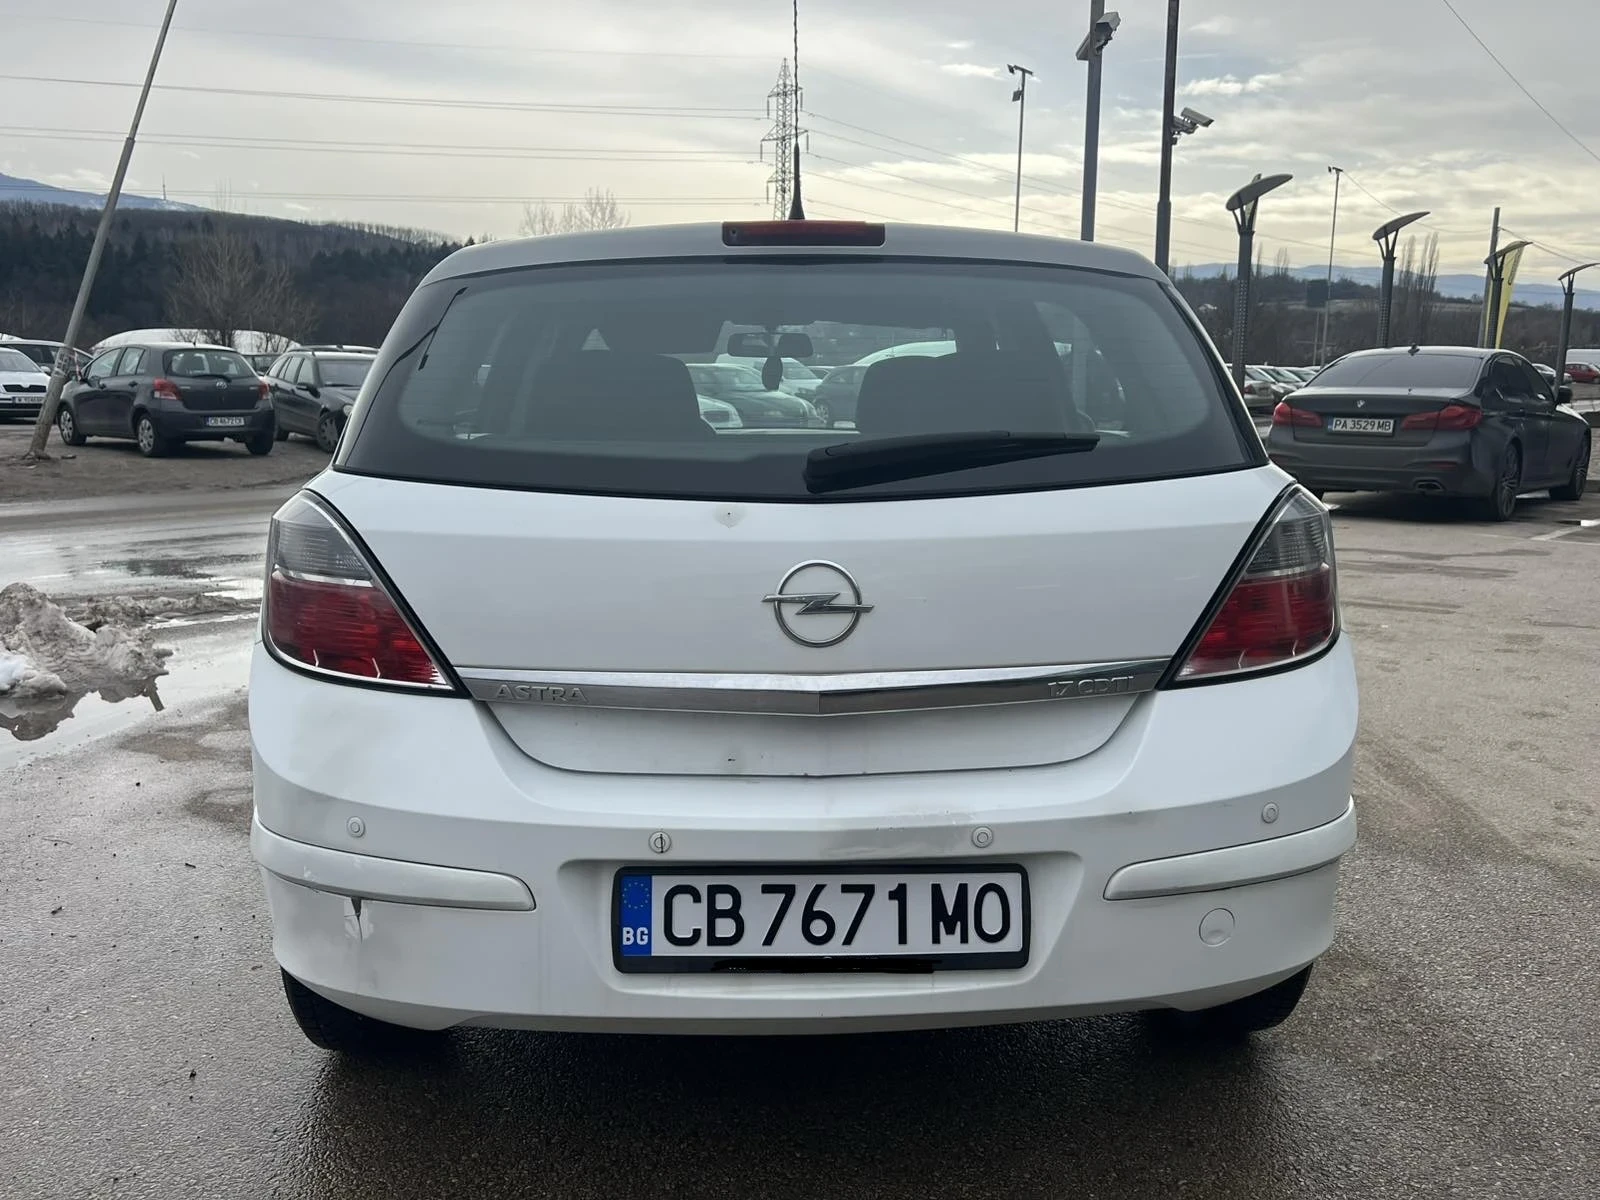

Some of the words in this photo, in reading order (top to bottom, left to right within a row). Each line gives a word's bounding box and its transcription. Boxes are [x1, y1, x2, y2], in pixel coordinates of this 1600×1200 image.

[1334, 419, 1348, 429] PA
[1350, 419, 1376, 431] 3529
[1377, 420, 1392, 432] MB
[495, 684, 590, 702] ASTRA
[1078, 675, 1134, 695] CDTI
[663, 884, 745, 947] CB
[760, 883, 908, 946] 7671
[931, 882, 1011, 945] MO
[622, 926, 649, 946] BG
